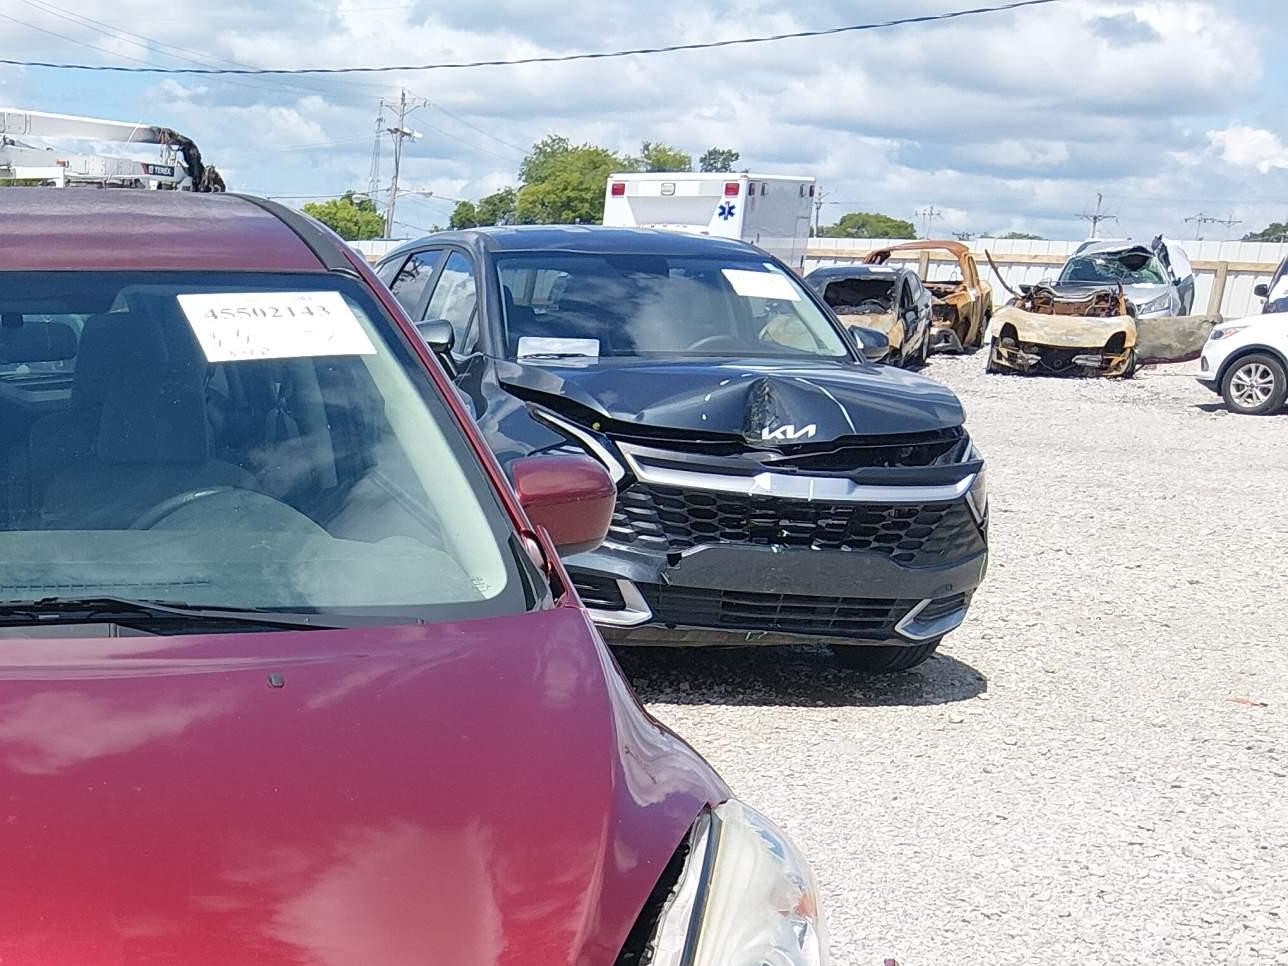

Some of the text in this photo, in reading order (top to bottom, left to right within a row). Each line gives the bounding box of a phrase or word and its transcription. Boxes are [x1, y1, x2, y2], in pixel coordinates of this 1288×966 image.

[155, 166, 172, 175] TEREX
[203, 304, 331, 321] 45502143
[761, 424, 817, 440] KIA
